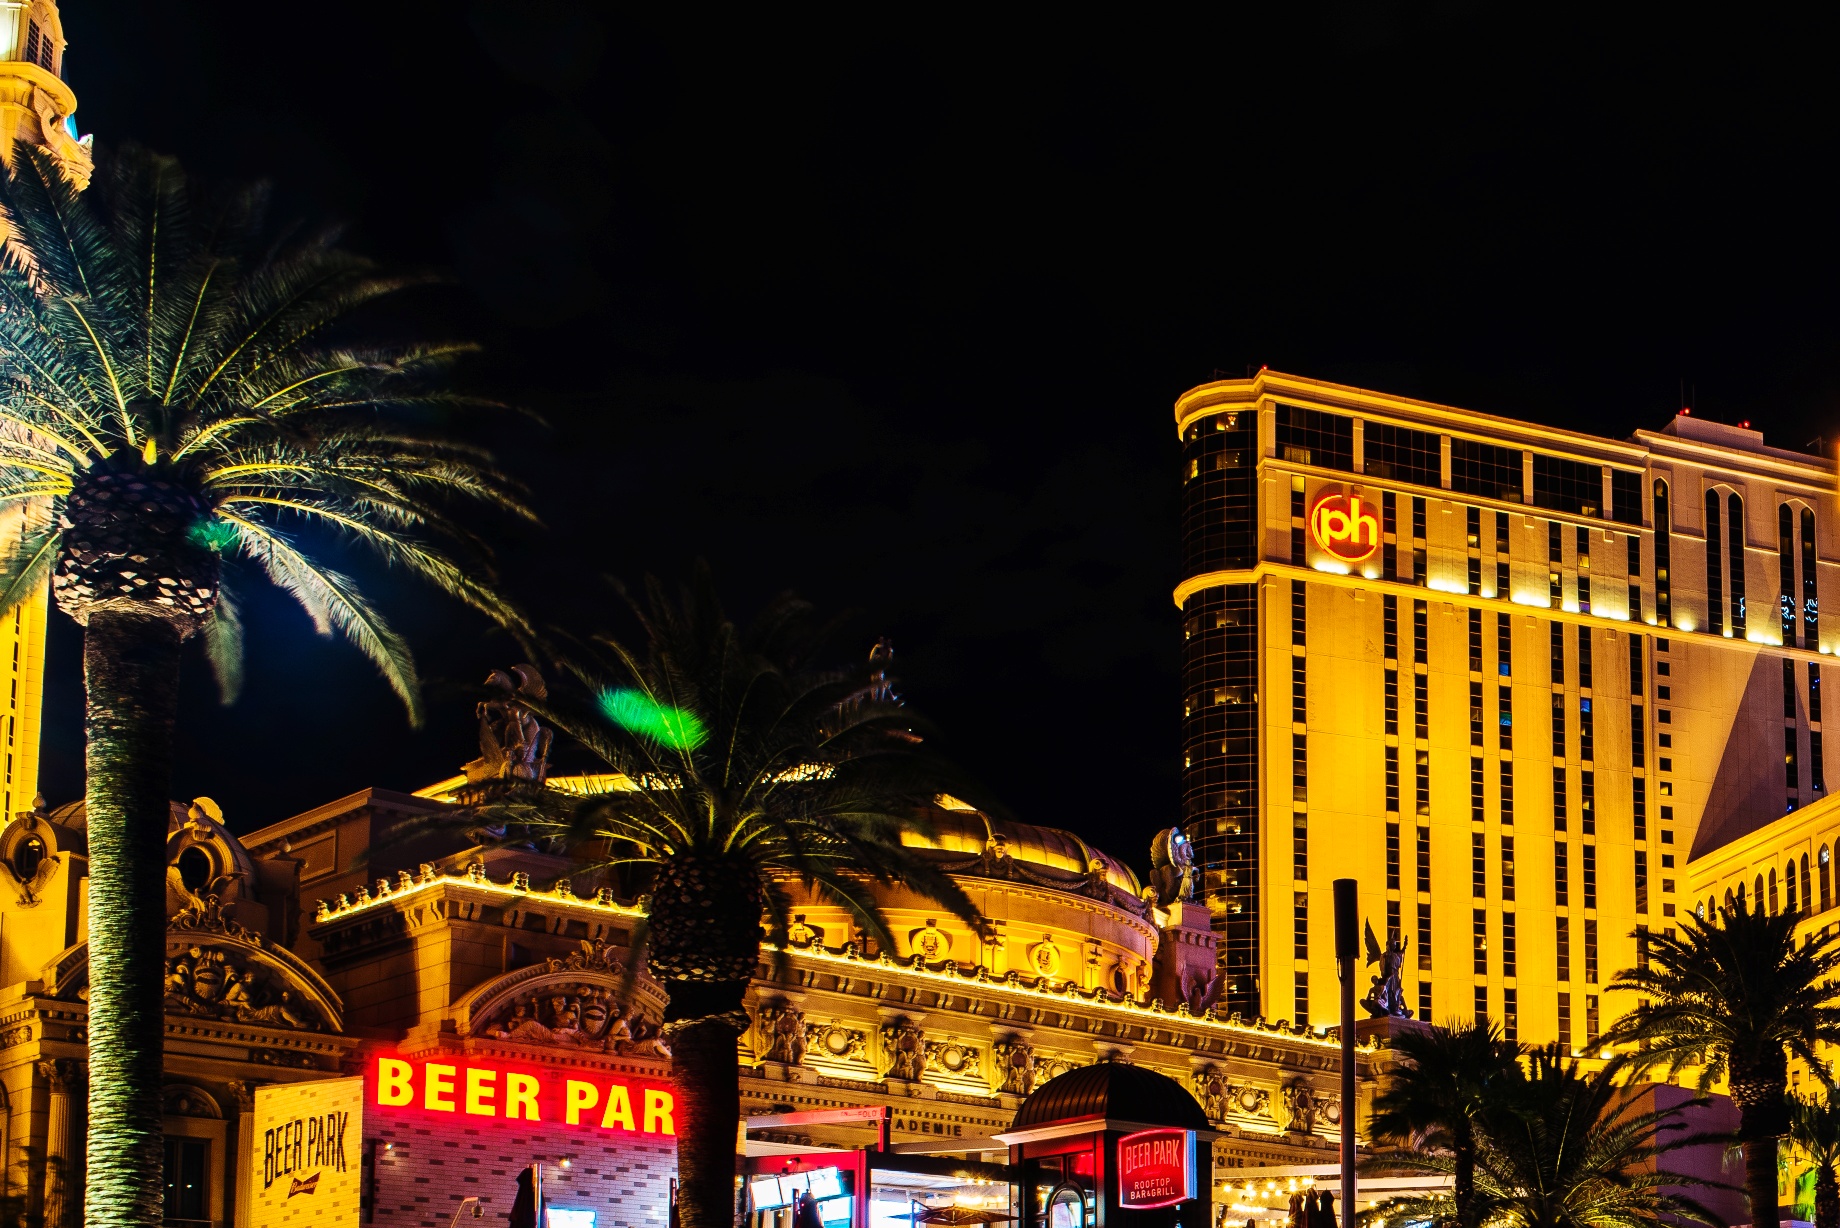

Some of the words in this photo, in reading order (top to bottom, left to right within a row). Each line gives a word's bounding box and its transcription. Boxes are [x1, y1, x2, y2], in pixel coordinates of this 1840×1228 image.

[1321, 497, 1377, 547] ph
[377, 1057, 541, 1121] BEER
[565, 1079, 676, 1136] PAR
[867, 1118, 963, 1137] AADEMIE
[264, 1119, 303, 1190] BEER
[307, 1111, 349, 1173] PARK
[1125, 1145, 1150, 1175] BEER
[1153, 1139, 1181, 1168] PARK
[1134, 1177, 1171, 1190] ROOFTOP
